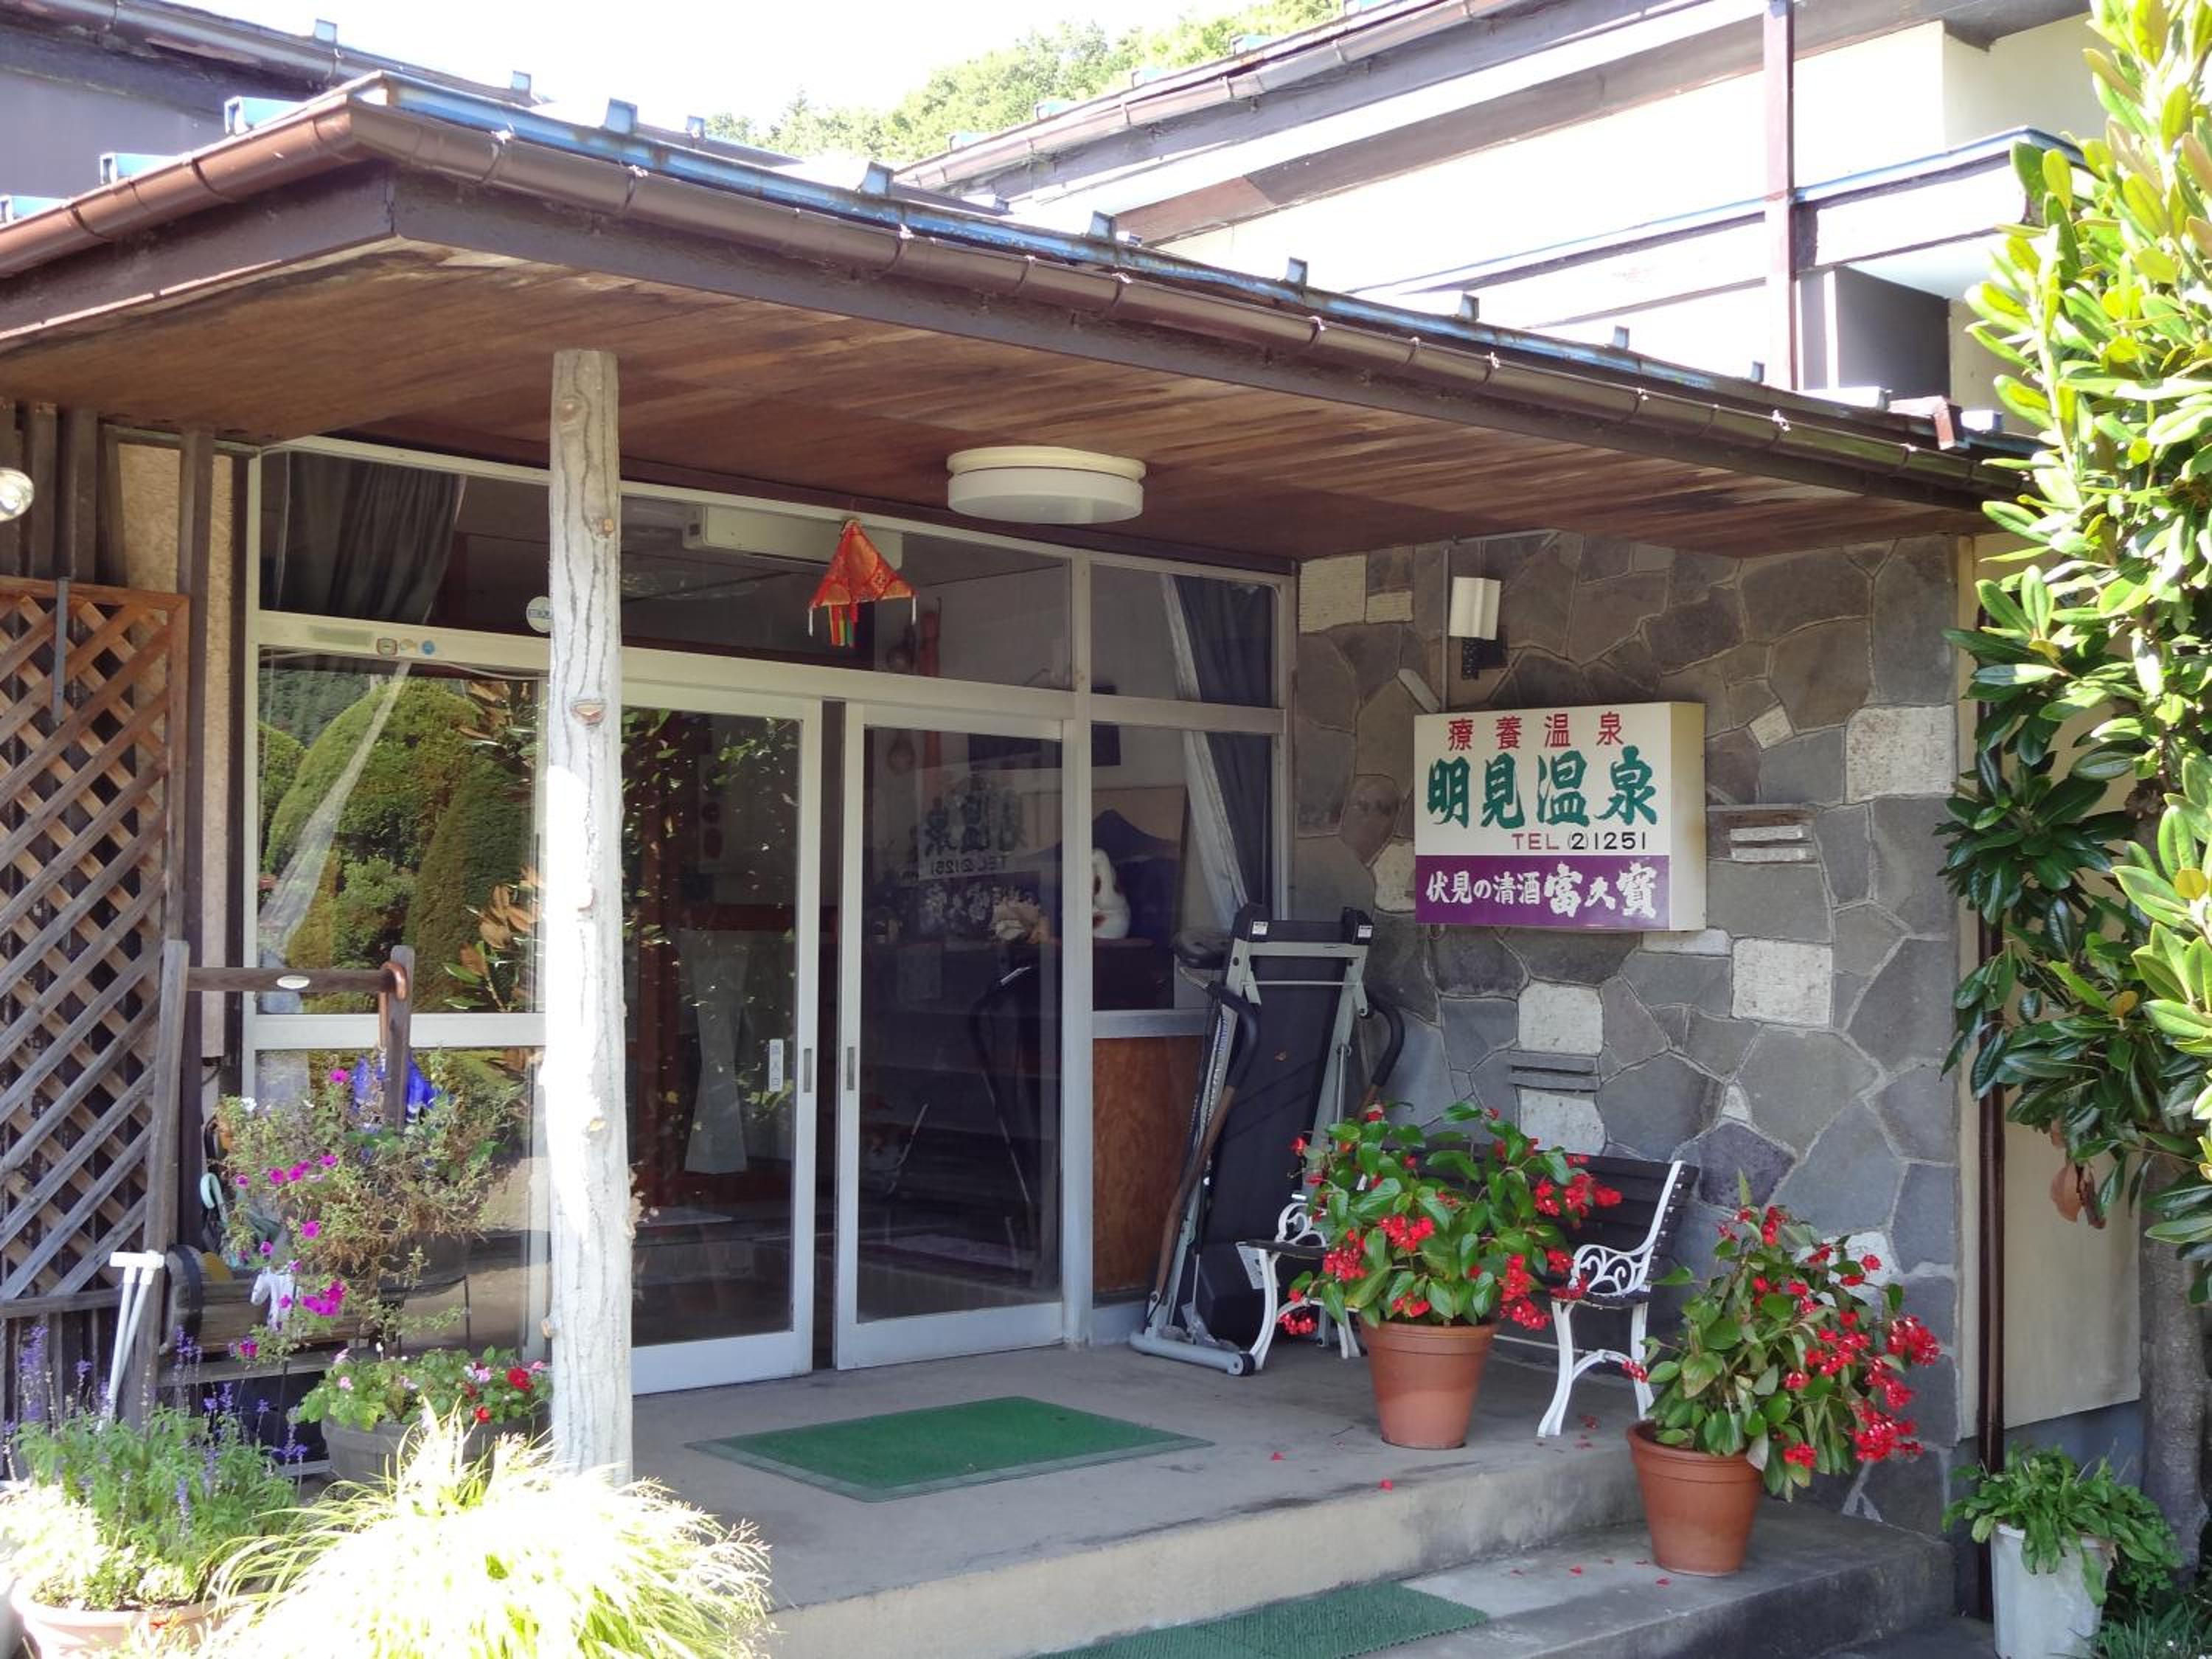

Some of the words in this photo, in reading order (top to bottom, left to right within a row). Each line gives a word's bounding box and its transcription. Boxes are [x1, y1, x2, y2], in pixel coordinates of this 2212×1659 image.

[1448, 711, 1624, 751] 療養温泉
[1427, 745, 1658, 830] 明見温泉
[1512, 833, 1559, 850] TEL
